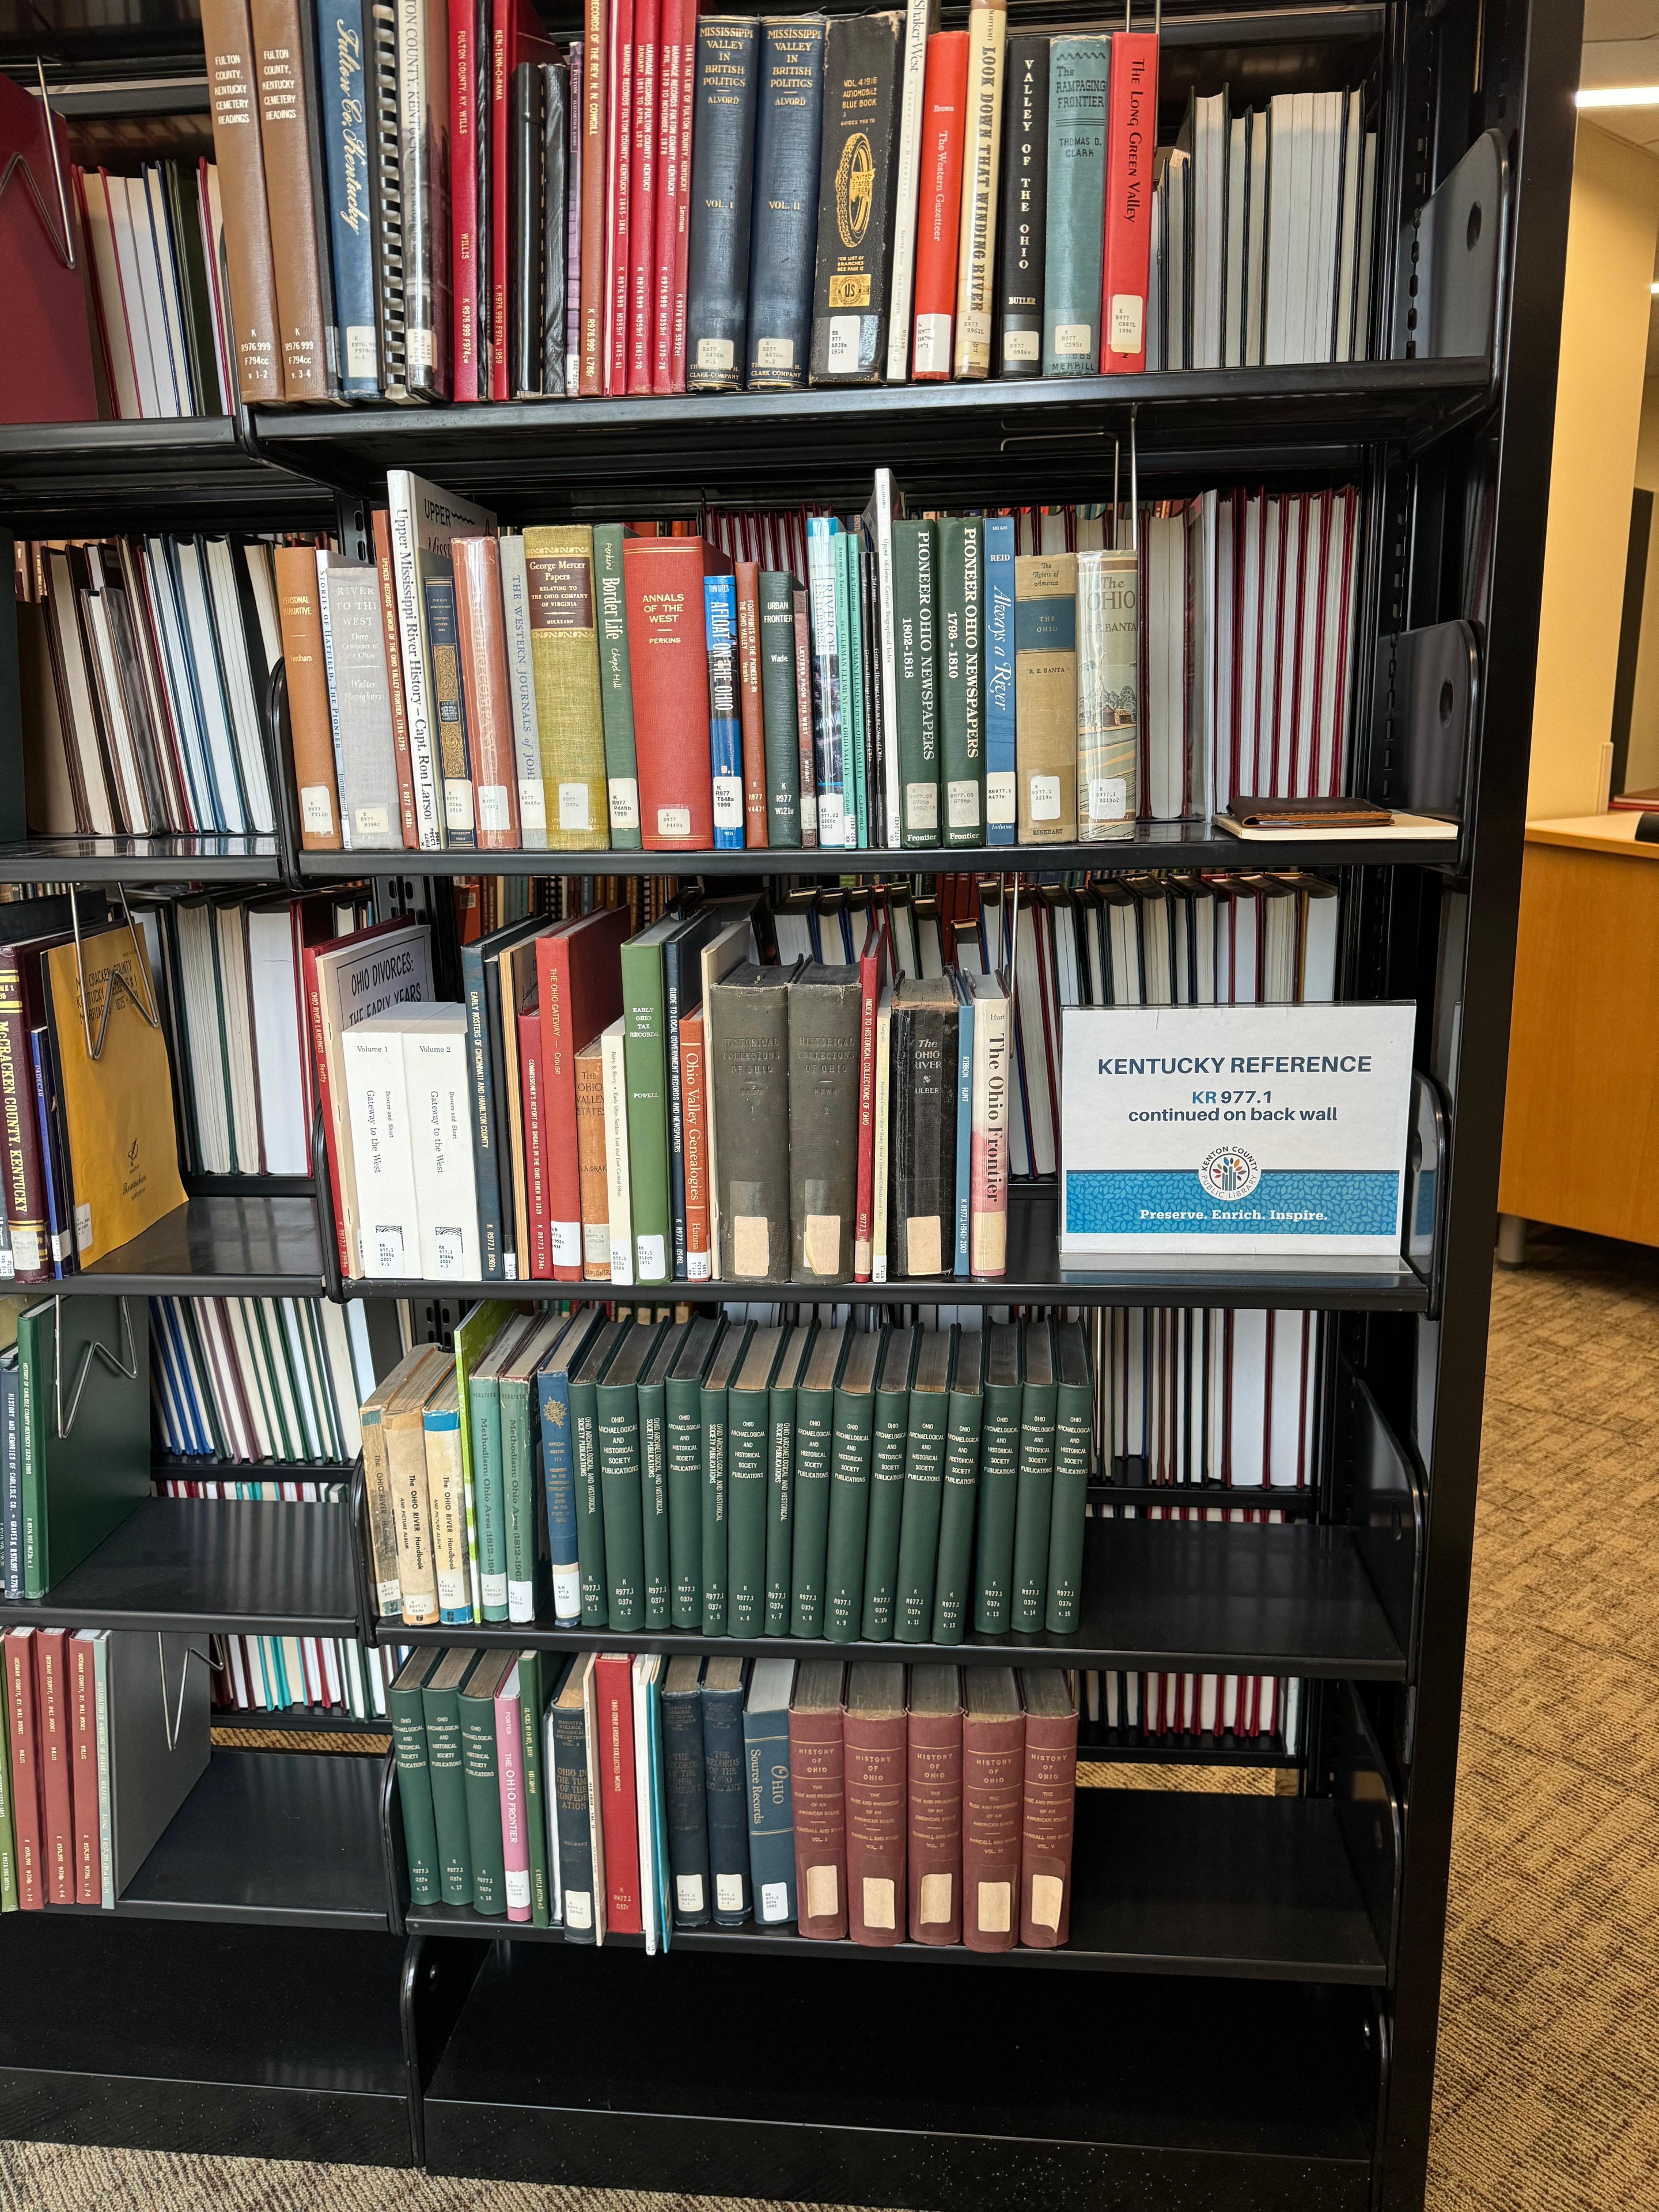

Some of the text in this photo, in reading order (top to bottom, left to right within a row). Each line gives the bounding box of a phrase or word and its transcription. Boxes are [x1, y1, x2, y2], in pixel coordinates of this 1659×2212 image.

[912, 0, 925, 40] Shaker
[700, 28, 753, 39] MISSISSIPPI
[707, 40, 744, 50] VALLEY
[215, 55, 240, 65] FULTON
[336, 18, 361, 98] Fulton
[495, 29, 503, 100] KEN-TENN-O-RAMA
[719, 52, 730, 61] IN
[910, 43, 922, 72] West
[705, 64, 744, 75] BRITISH
[1056, 66, 1074, 77] The
[214, 84, 247, 96] KENTUCKY
[703, 77, 745, 87] POLITICS
[1056, 80, 1106, 93] RAMPAGING
[707, 96, 740, 105] ALVORD
[843, 88, 877, 98] AUTOMOBILE
[215, 99, 248, 110] CEMETERY
[842, 98, 877, 108] BLUE BOOK
[1058, 97, 1104, 108] FRONTIER
[218, 113, 249, 125] READINGS
[1059, 138, 1090, 147] THOMAS
[1066, 149, 1094, 157] CLARK
[1019, 59, 1035, 269] VALLEY OF THE OHIO
[343, 128, 368, 236] Kentucky
[934, 130, 948, 241] The Western Gazetteer
[970, 46, 996, 312] LOOK DOWN THAT WINDING RIVER
[844, 283, 855, 297] US
[1009, 297, 1036, 305] BUTLER
[1052, 362, 1094, 372] MERRILL
[529, 561, 586, 571] George Mercer
[545, 573, 570, 583] Papers
[642, 594, 684, 603] ANNALS
[602, 578, 622, 639] Border Life
[643, 605, 656, 613] OF
[988, 585, 1012, 643] Always
[395, 509, 429, 775] Upper Mississippi River History Capt. Ron
[903, 618, 914, 679] 1802-1818
[918, 531, 935, 760] PIONEER OHIO NEWSPAPERS
[711, 601, 733, 710] AFLOAT ON THE OHIO
[989, 662, 1012, 711] River
[351, 952, 414, 997] OHIO DIVORCES:
[550, 968, 558, 982] THE
[552, 1005, 560, 1036] GATEWAY
[1098, 1056, 1372, 1075] KENTUCKY REFERENCE
[1192, 1090, 1272, 1104] KR 977.1
[367, 1090, 375, 1124] Gateway
[1128, 1107, 1337, 1122] continued on back wall
[5, 1097, 20, 1147] COUNTY,
[987, 1033, 1004, 1202] The Ohio Frontier
[686, 1052, 701, 1201] Ohio Valley Genealogies
[1202, 1146, 1257, 1171] KENTON COUNTY
[10, 1150, 27, 1213] KENTUCKY
[1202, 1175, 1257, 1198] PUBLIC LIBRARY
[1140, 1209, 1328, 1221] Preserve. Enrich. Inspire.
[415, 1536, 423, 1570] Handbook
[751, 1749, 764, 1824] Source Records
[771, 1765, 789, 1804] OHIO
